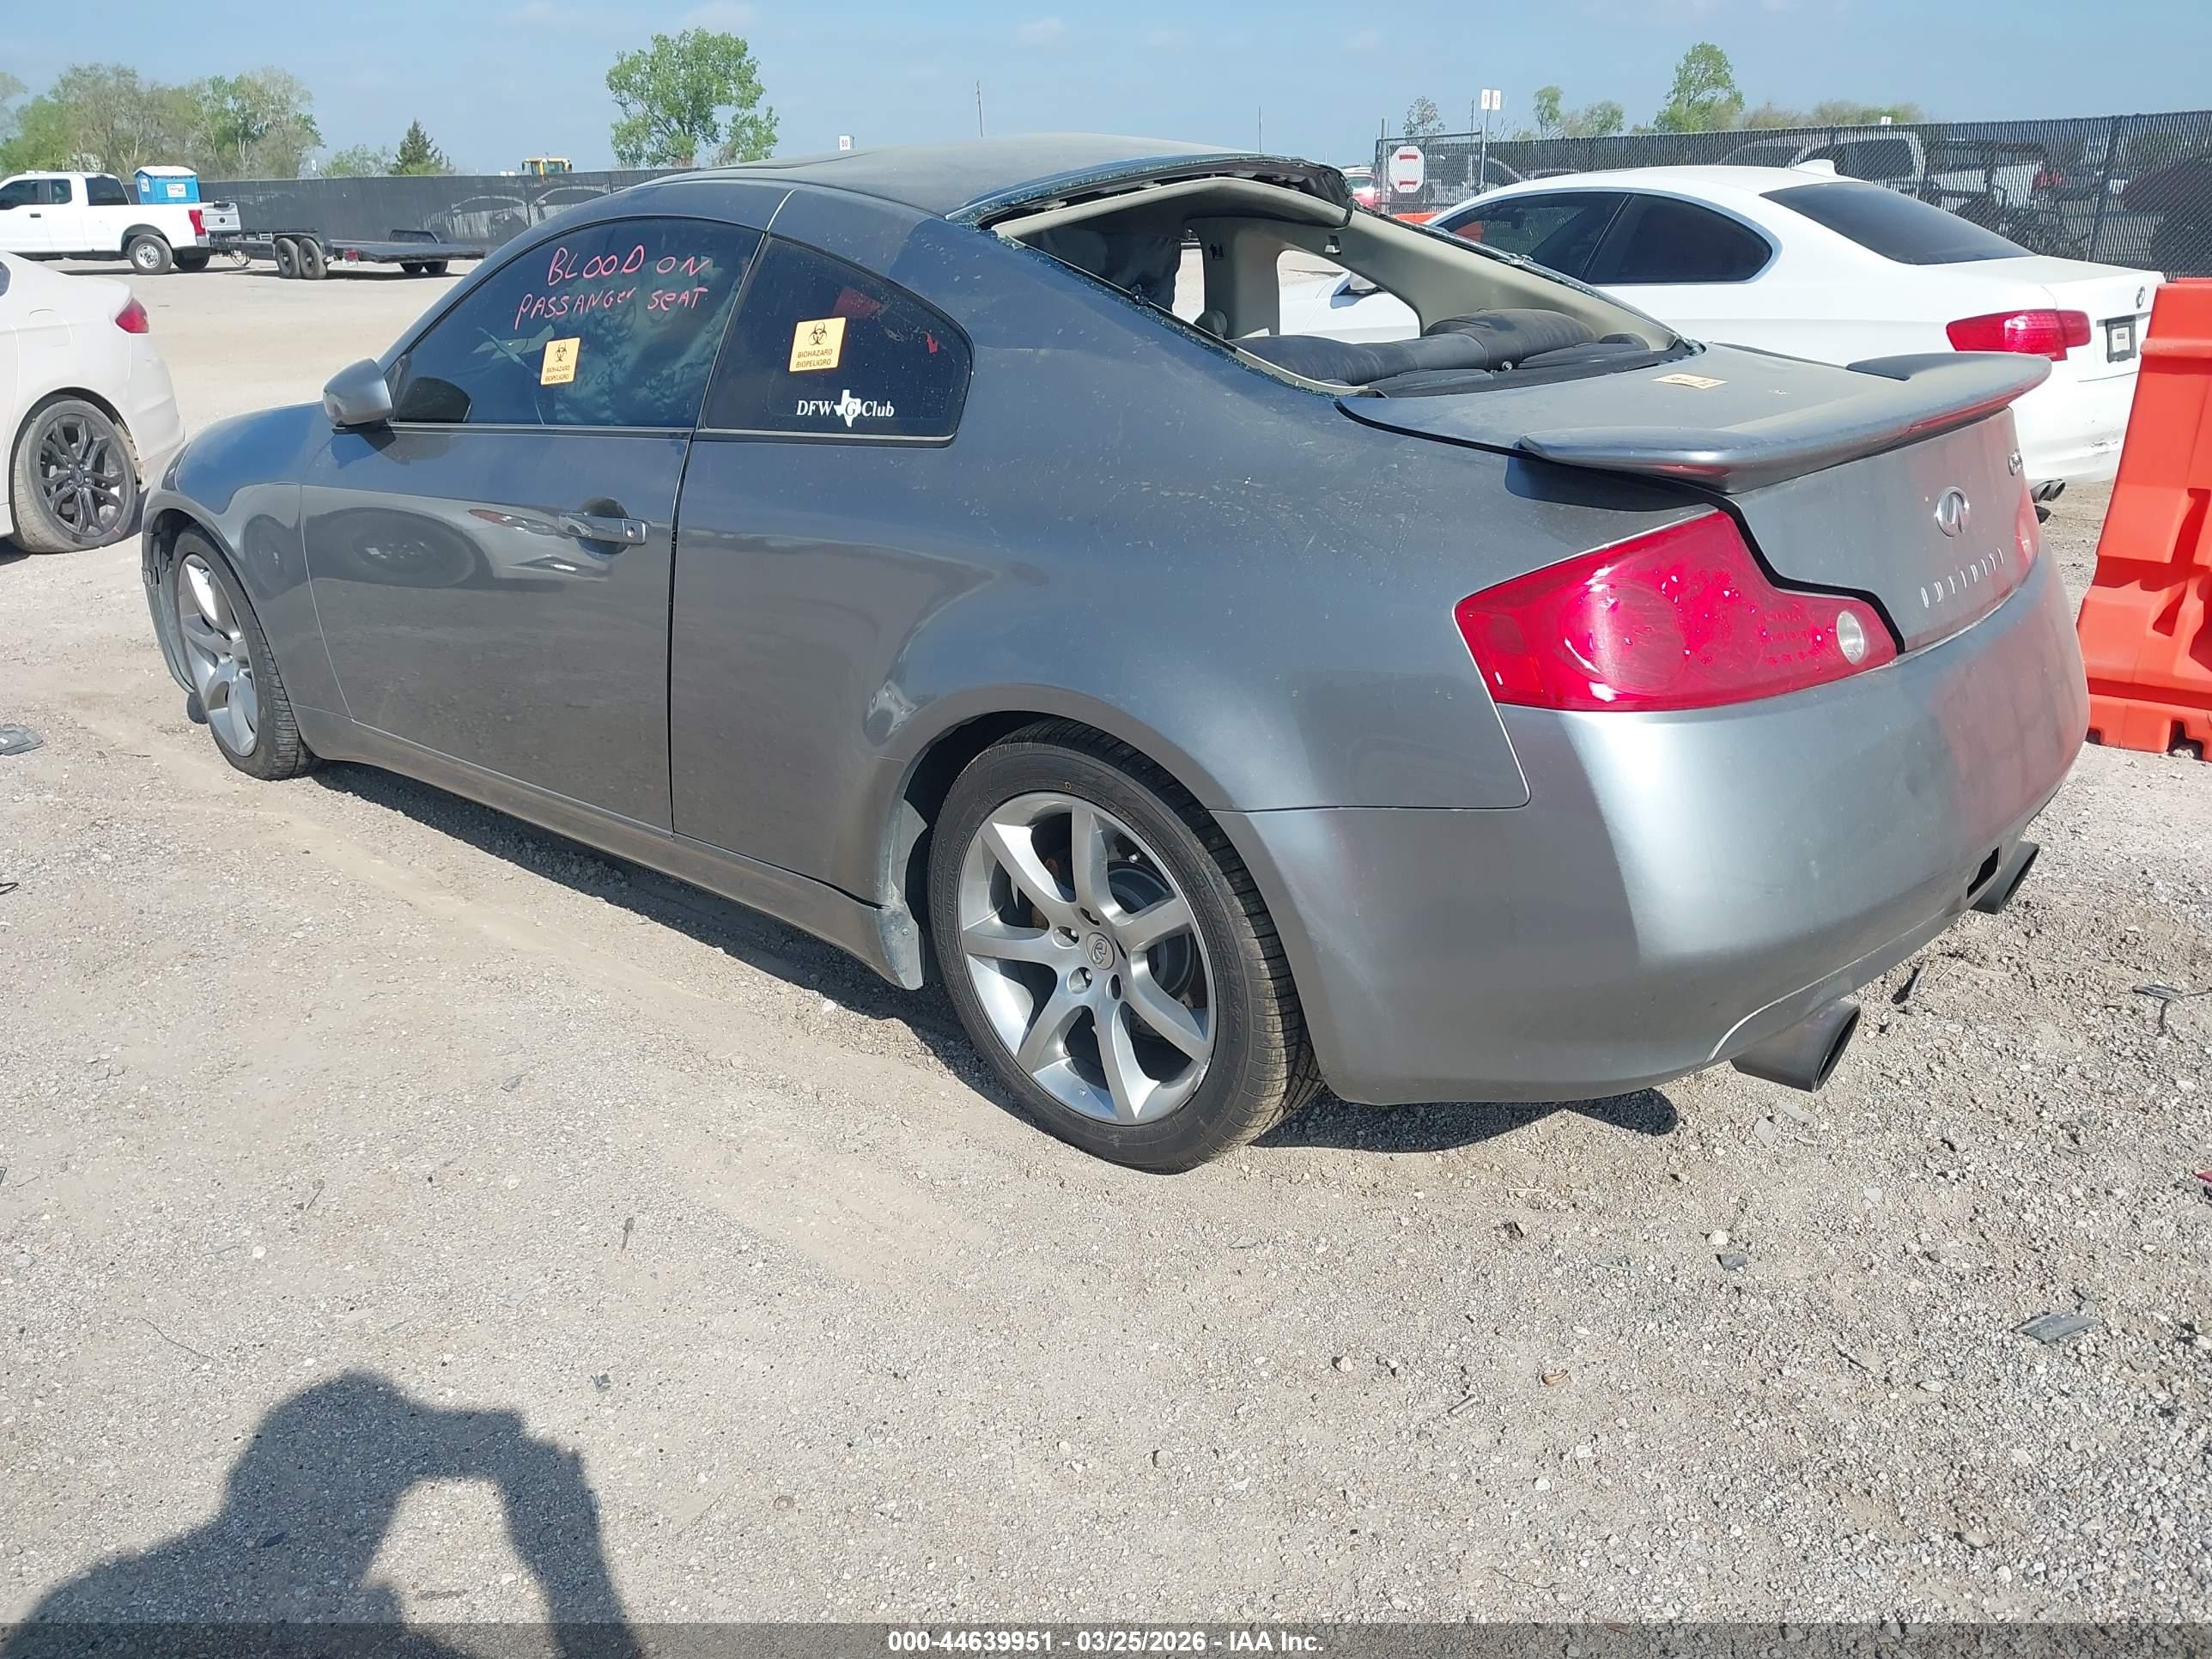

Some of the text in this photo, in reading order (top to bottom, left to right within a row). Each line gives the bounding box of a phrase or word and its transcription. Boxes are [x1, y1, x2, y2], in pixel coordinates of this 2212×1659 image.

[547, 245, 711, 286] BLOOD ON
[798, 349, 833, 359] BIOHAZARD
[795, 358, 832, 368] BIOPELIGRO
[796, 400, 835, 416] DFW
[861, 400, 895, 417] Club
[1920, 548, 2004, 608] INFINITI
